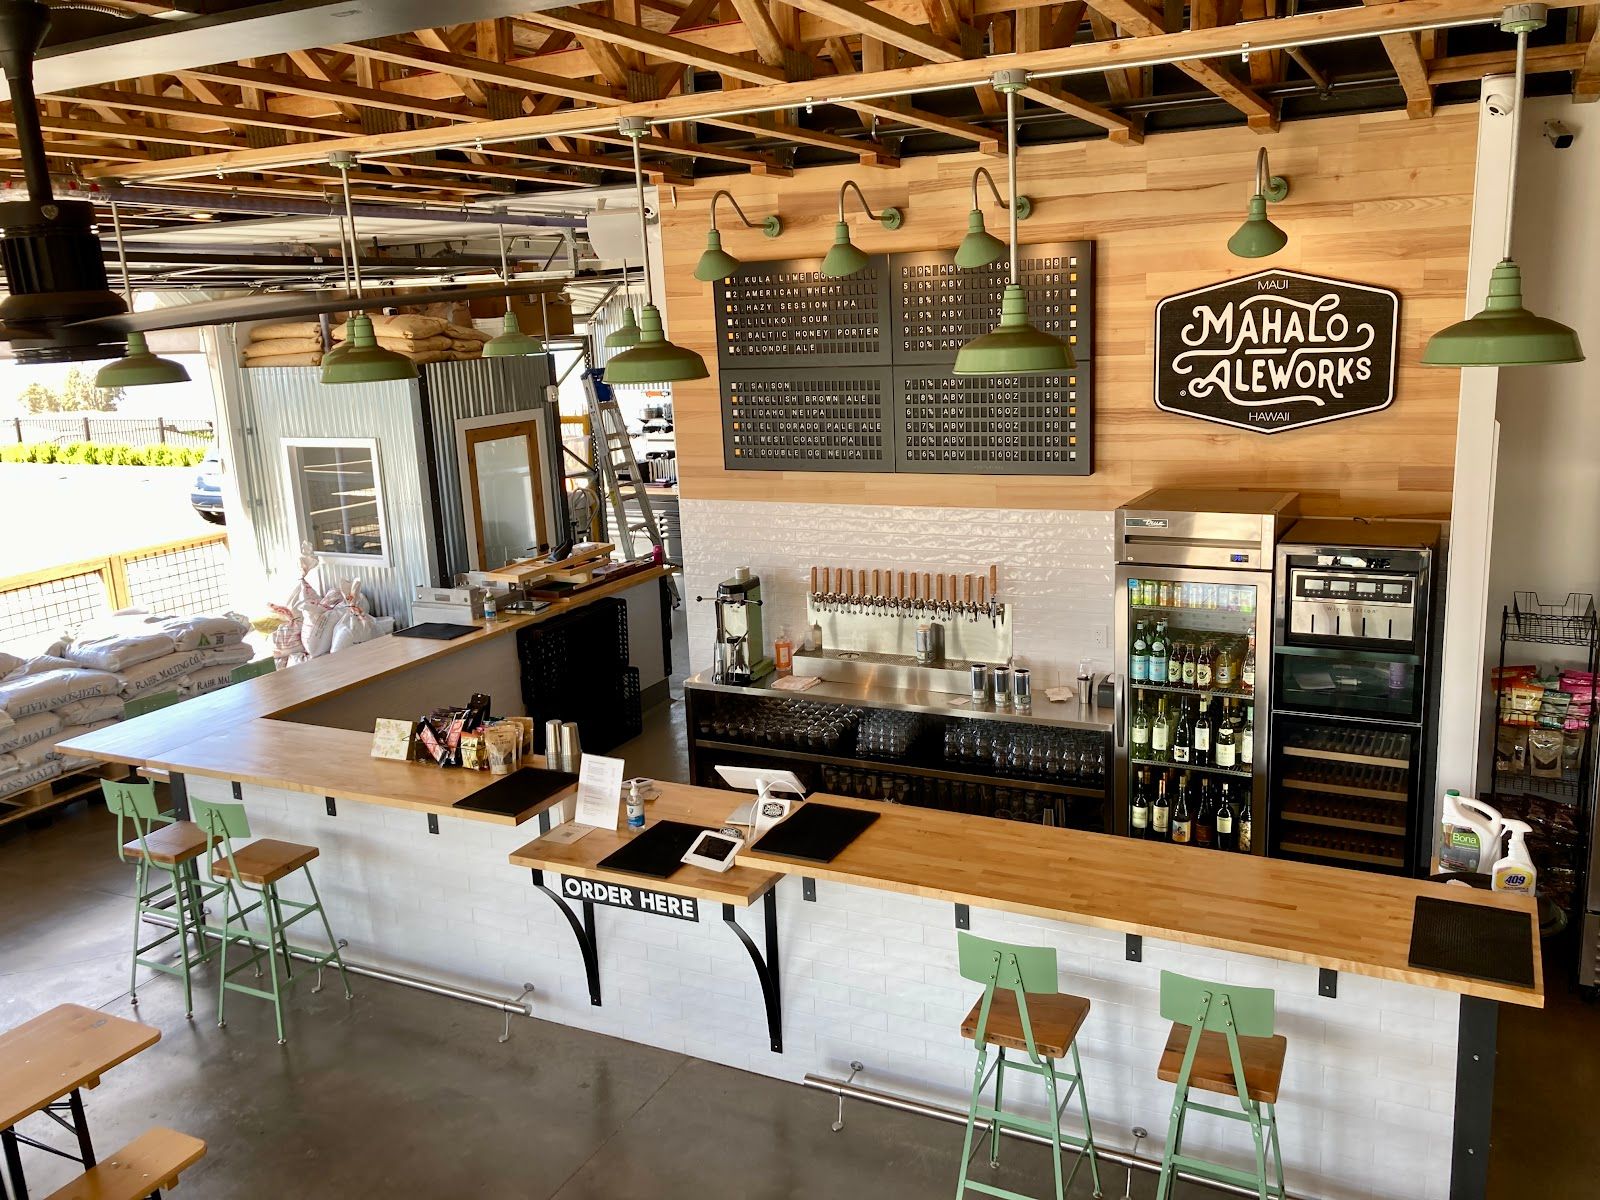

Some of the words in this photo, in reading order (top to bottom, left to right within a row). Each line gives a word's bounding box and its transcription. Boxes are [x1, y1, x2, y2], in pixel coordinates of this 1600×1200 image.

[744, 275, 771, 283] KULA
[779, 273, 805, 282] LIME
[1257, 280, 1289, 290] MAUI
[745, 288, 800, 297] AMERICAN
[806, 286, 841, 295] WHEAT
[941, 295, 962, 303] ABV
[746, 303, 772, 311] HAZY
[780, 301, 828, 310] SESSION
[837, 300, 856, 308] IPA
[941, 310, 962, 318] ABV
[747, 316, 793, 325] LILIKOI
[801, 315, 829, 323] SOUR
[1178, 293, 1349, 351] MAHALO
[748, 331, 787, 339] BALTIC
[795, 329, 829, 338] HONEY
[837, 327, 880, 336] PORTER
[749, 344, 788, 353] BLONDE
[1186, 353, 1373, 407] ALEWORKS
[1249, 412, 1290, 422] HAWAII
[943, 436, 964, 444] ABV
[1046, 436, 1059, 444] $9
[807, 449, 820, 457] OG
[828, 449, 861, 457] NEIPA
[1046, 450, 1059, 458] $9
[135, 673, 158, 690] RAHR
[158, 661, 189, 678] MALTING
[197, 678, 215, 691] RAHR
[17, 701, 50, 716] MALT
[1452, 833, 1477, 844] Bona
[1505, 875, 1526, 886] 409
[564, 877, 634, 906] ORDER
[640, 891, 695, 918] HERE
